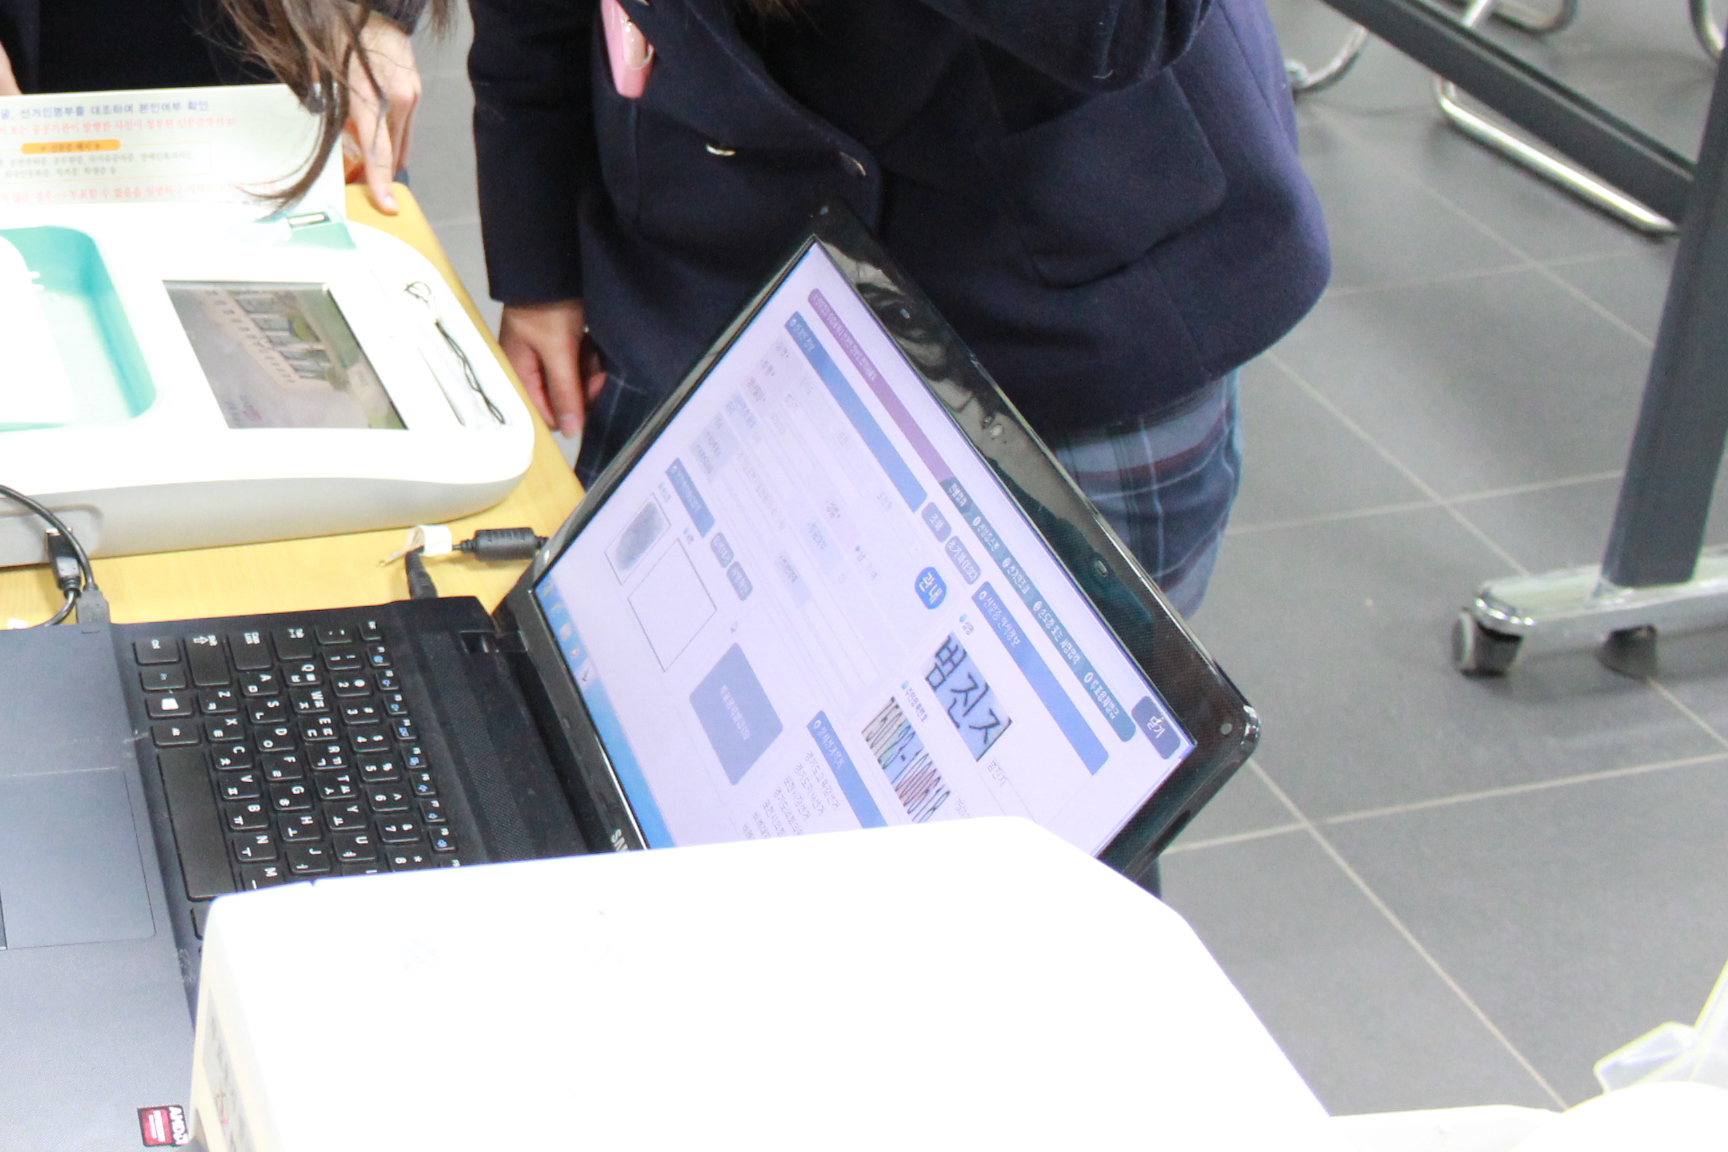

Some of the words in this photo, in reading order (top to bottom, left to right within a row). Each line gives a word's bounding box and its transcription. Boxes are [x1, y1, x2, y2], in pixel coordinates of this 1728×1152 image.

[21, 105, 84, 119] 선거인명부를
[139, 101, 181, 113] 본인여부
[187, 99, 208, 111] 확인
[981, 594, 1003, 623] 신분증
[311, 691, 323, 700] W
[925, 630, 1013, 763] 범진지
[1145, 713, 1166, 740] 닫기
[383, 763, 392, 771] %
[802, 748, 841, 812] 경기도교육감선거
[292, 786, 304, 794] G
[792, 760, 826, 818] 경기도지사선거
[301, 816, 313, 824] H
[257, 835, 268, 844] N
[356, 836, 368, 844] U
[265, 867, 277, 877] M
